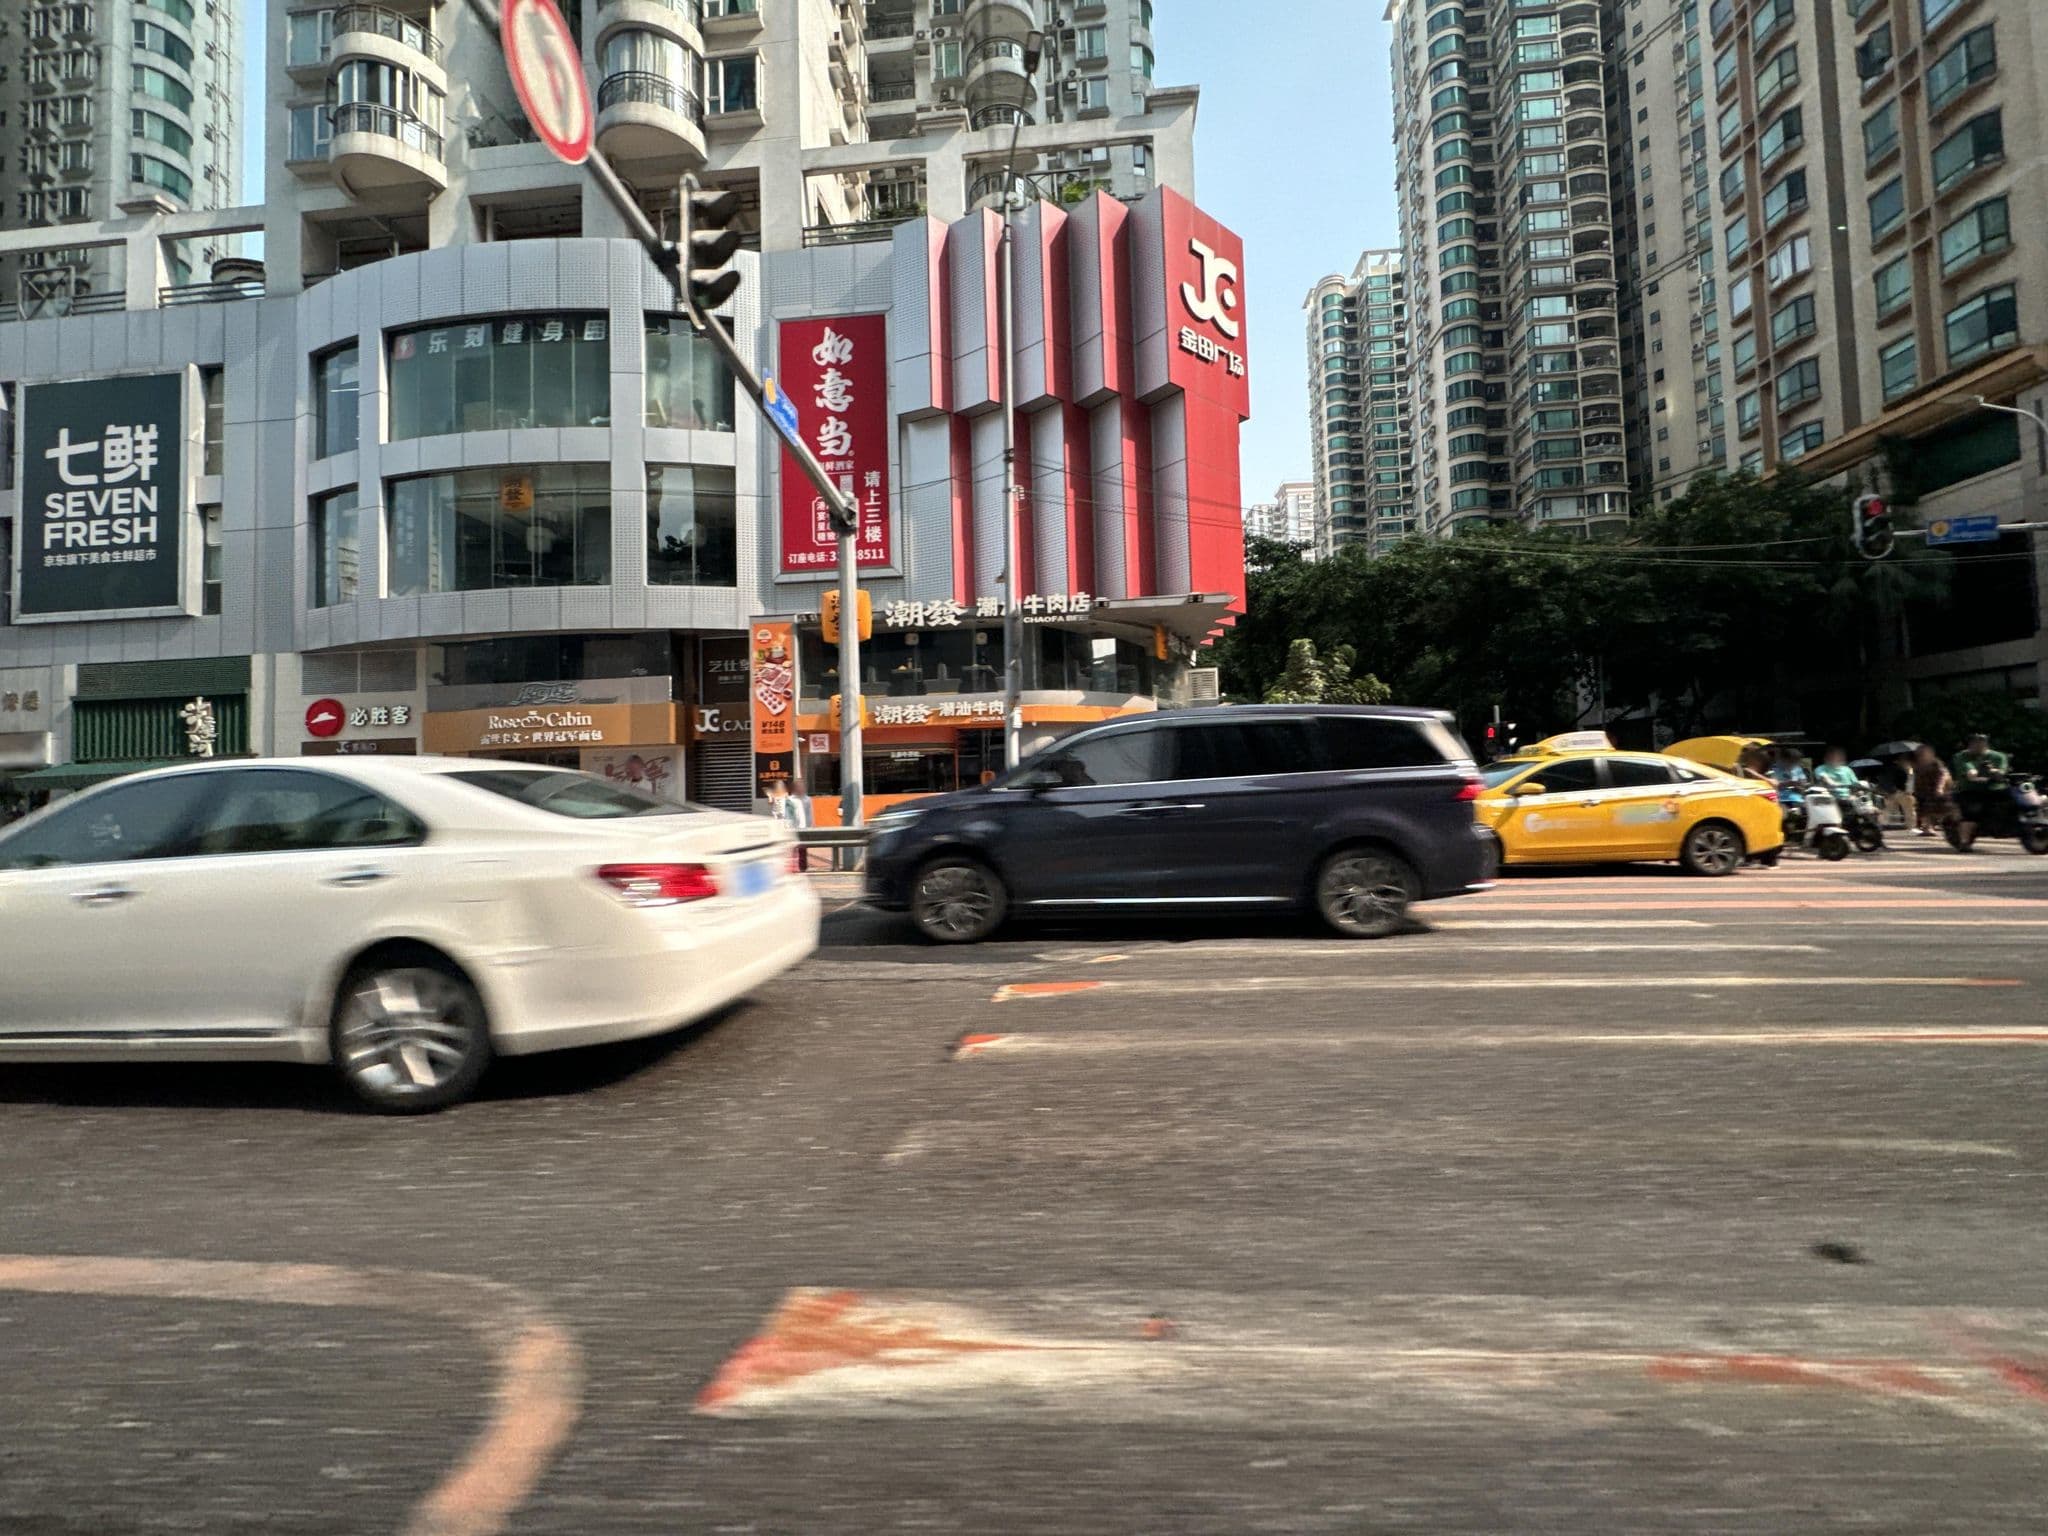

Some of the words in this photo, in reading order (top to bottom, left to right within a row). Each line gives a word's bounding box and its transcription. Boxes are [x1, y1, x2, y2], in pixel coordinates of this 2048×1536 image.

[1180, 325, 1245, 377] 金田广场
[44, 423, 159, 486] 七鲜
[44, 486, 158, 519] SEVEN
[863, 470, 882, 543] 请上三楼
[43, 516, 158, 550] FRESH
[43, 548, 158, 567] 京东旗下美食生鲜超市
[976, 591, 1091, 618] 潮牛肉店
[1023, 615, 1065, 624] CHAOFA
[350, 705, 409, 726] 必胜客
[488, 715, 521, 729] Rose
[546, 711, 592, 727] Cabin
